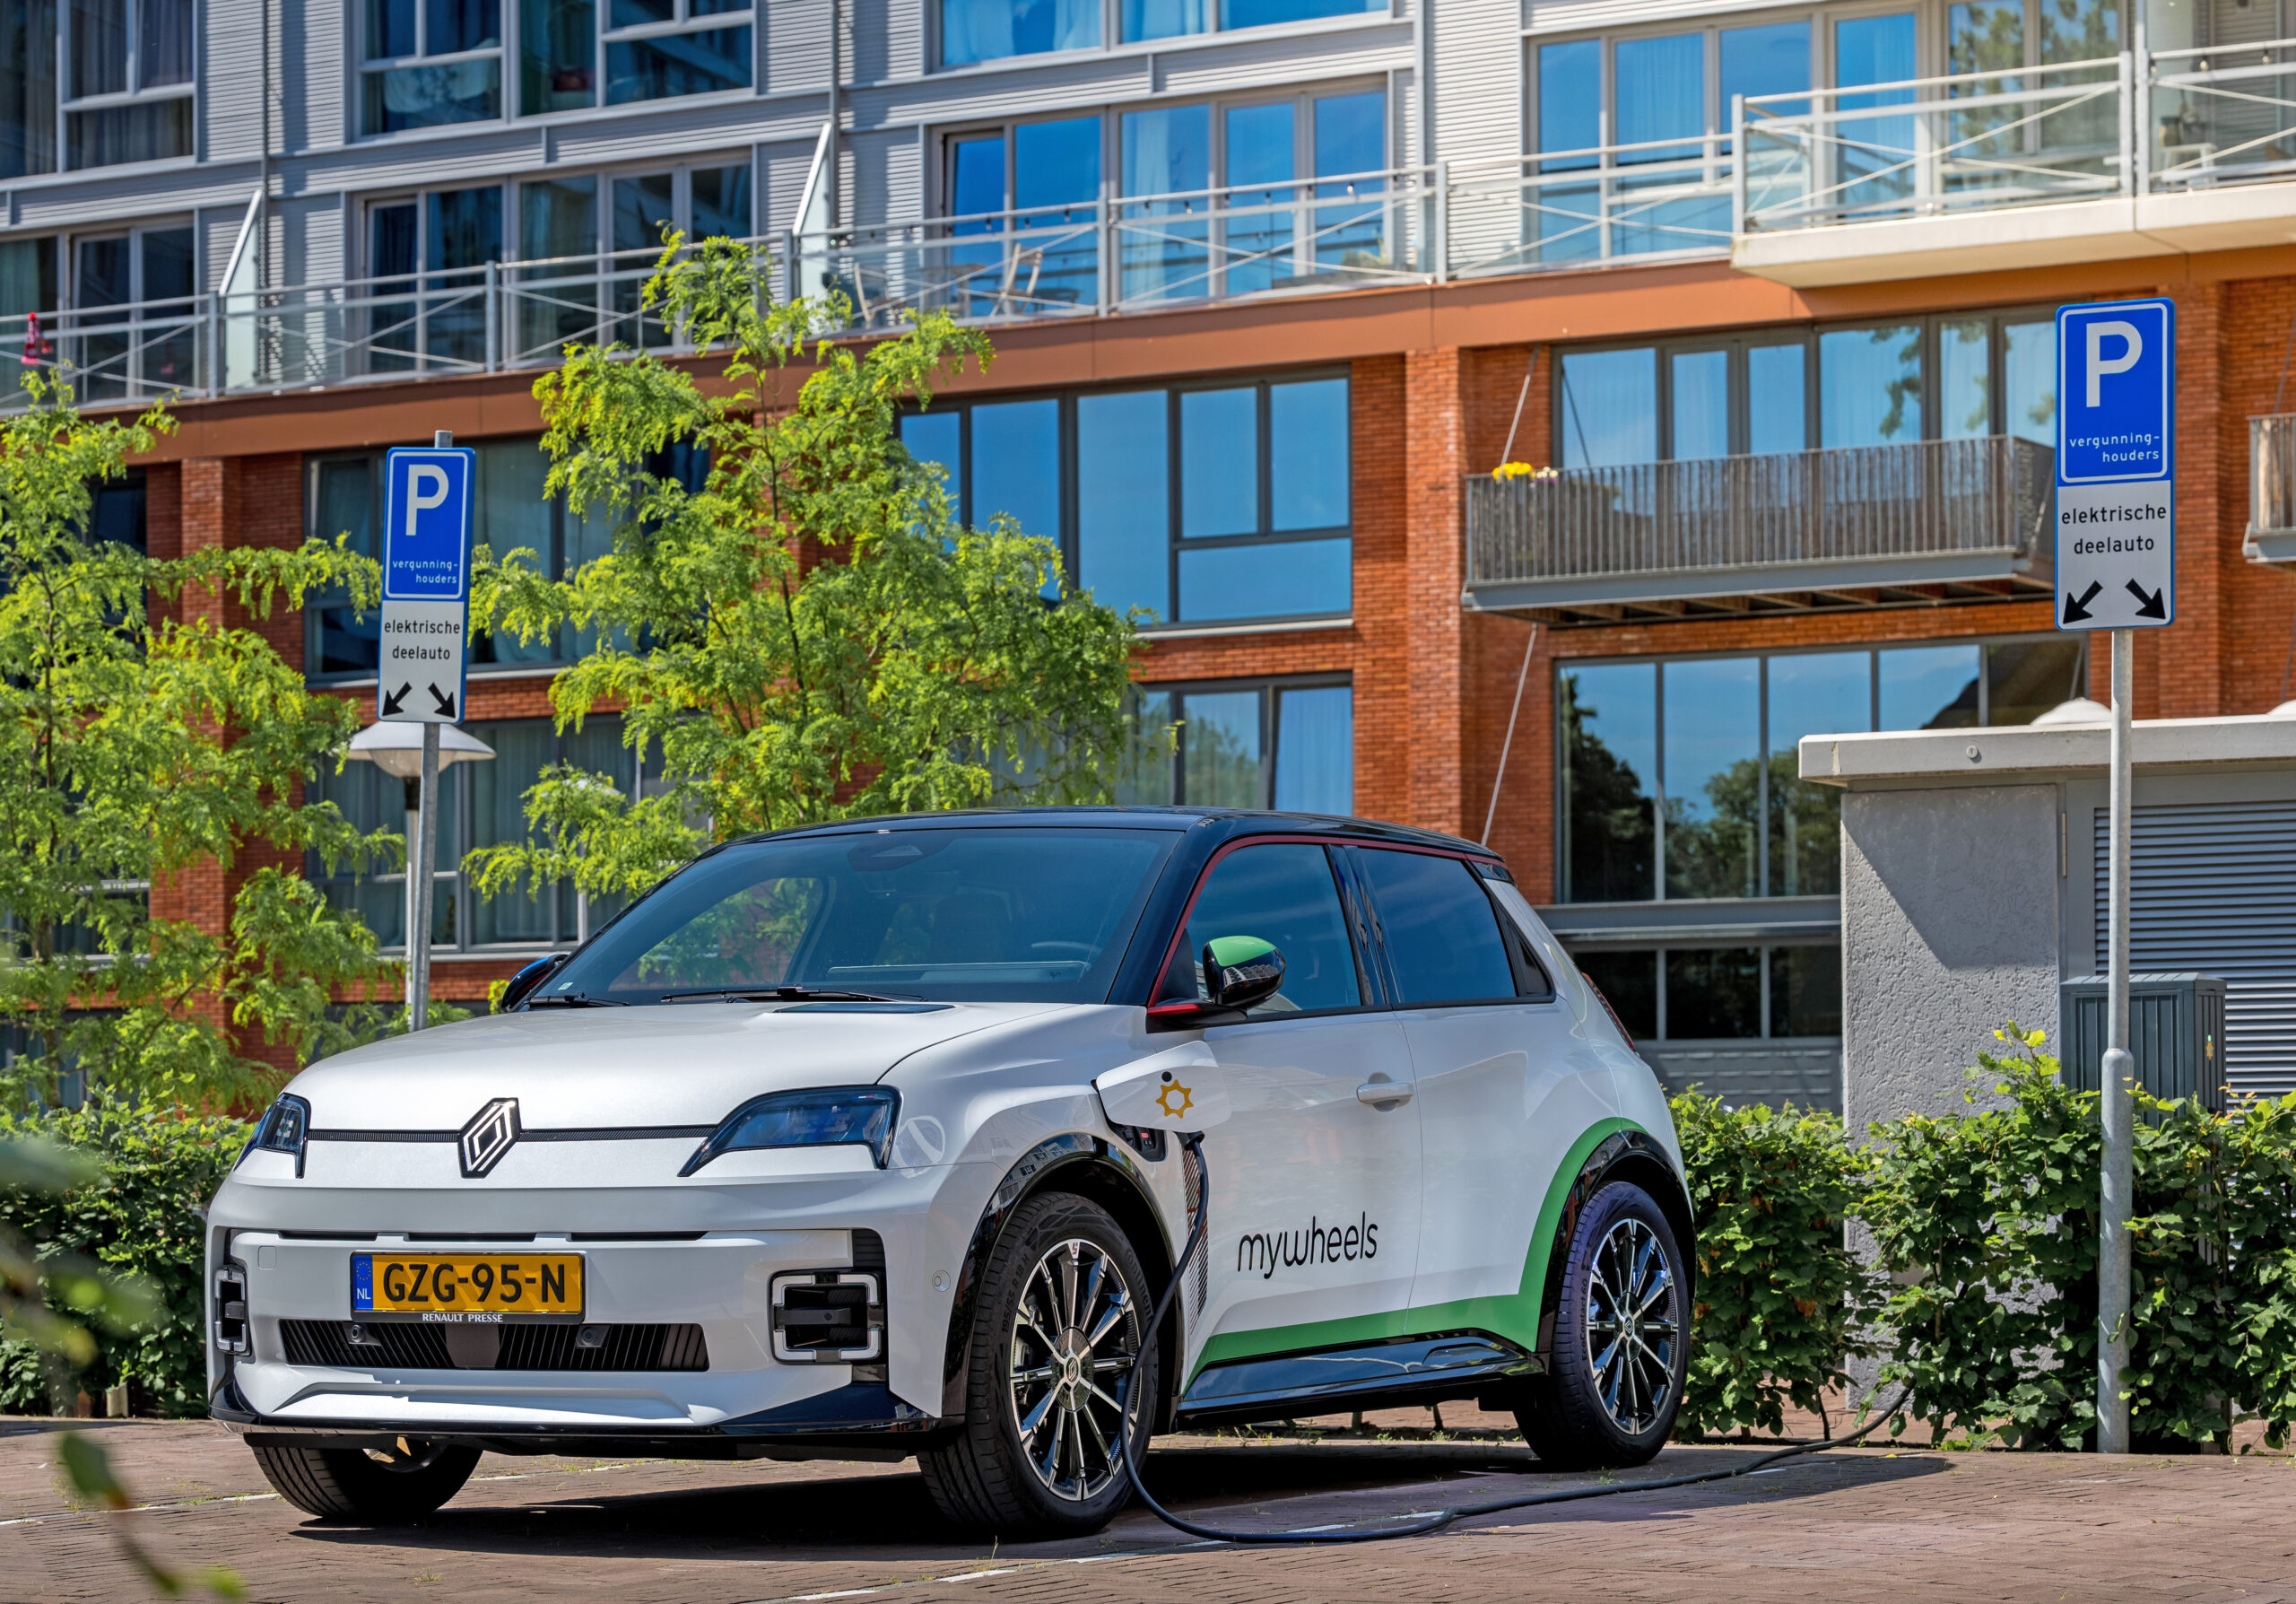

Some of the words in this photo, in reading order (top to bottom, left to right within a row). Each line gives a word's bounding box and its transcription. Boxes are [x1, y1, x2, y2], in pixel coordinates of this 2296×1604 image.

[2086, 320, 2143, 407] P
[2069, 432, 2160, 449] vergunning-
[2102, 449, 2160, 462] houders
[405, 464, 449, 536] P
[2061, 503, 2167, 525] elektrische
[2074, 535, 2154, 554] deelauto
[392, 559, 458, 571] vergunning-
[415, 573, 457, 584] houders
[384, 619, 460, 634] elektrische
[392, 645, 450, 660] deelauto
[1237, 1211, 1378, 1279] mywheels
[383, 1262, 566, 1303] GZG-95-N
[356, 1287, 371, 1301] NL
[422, 1313, 464, 1322] RENAULT
[468, 1313, 503, 1323] PRESSE
